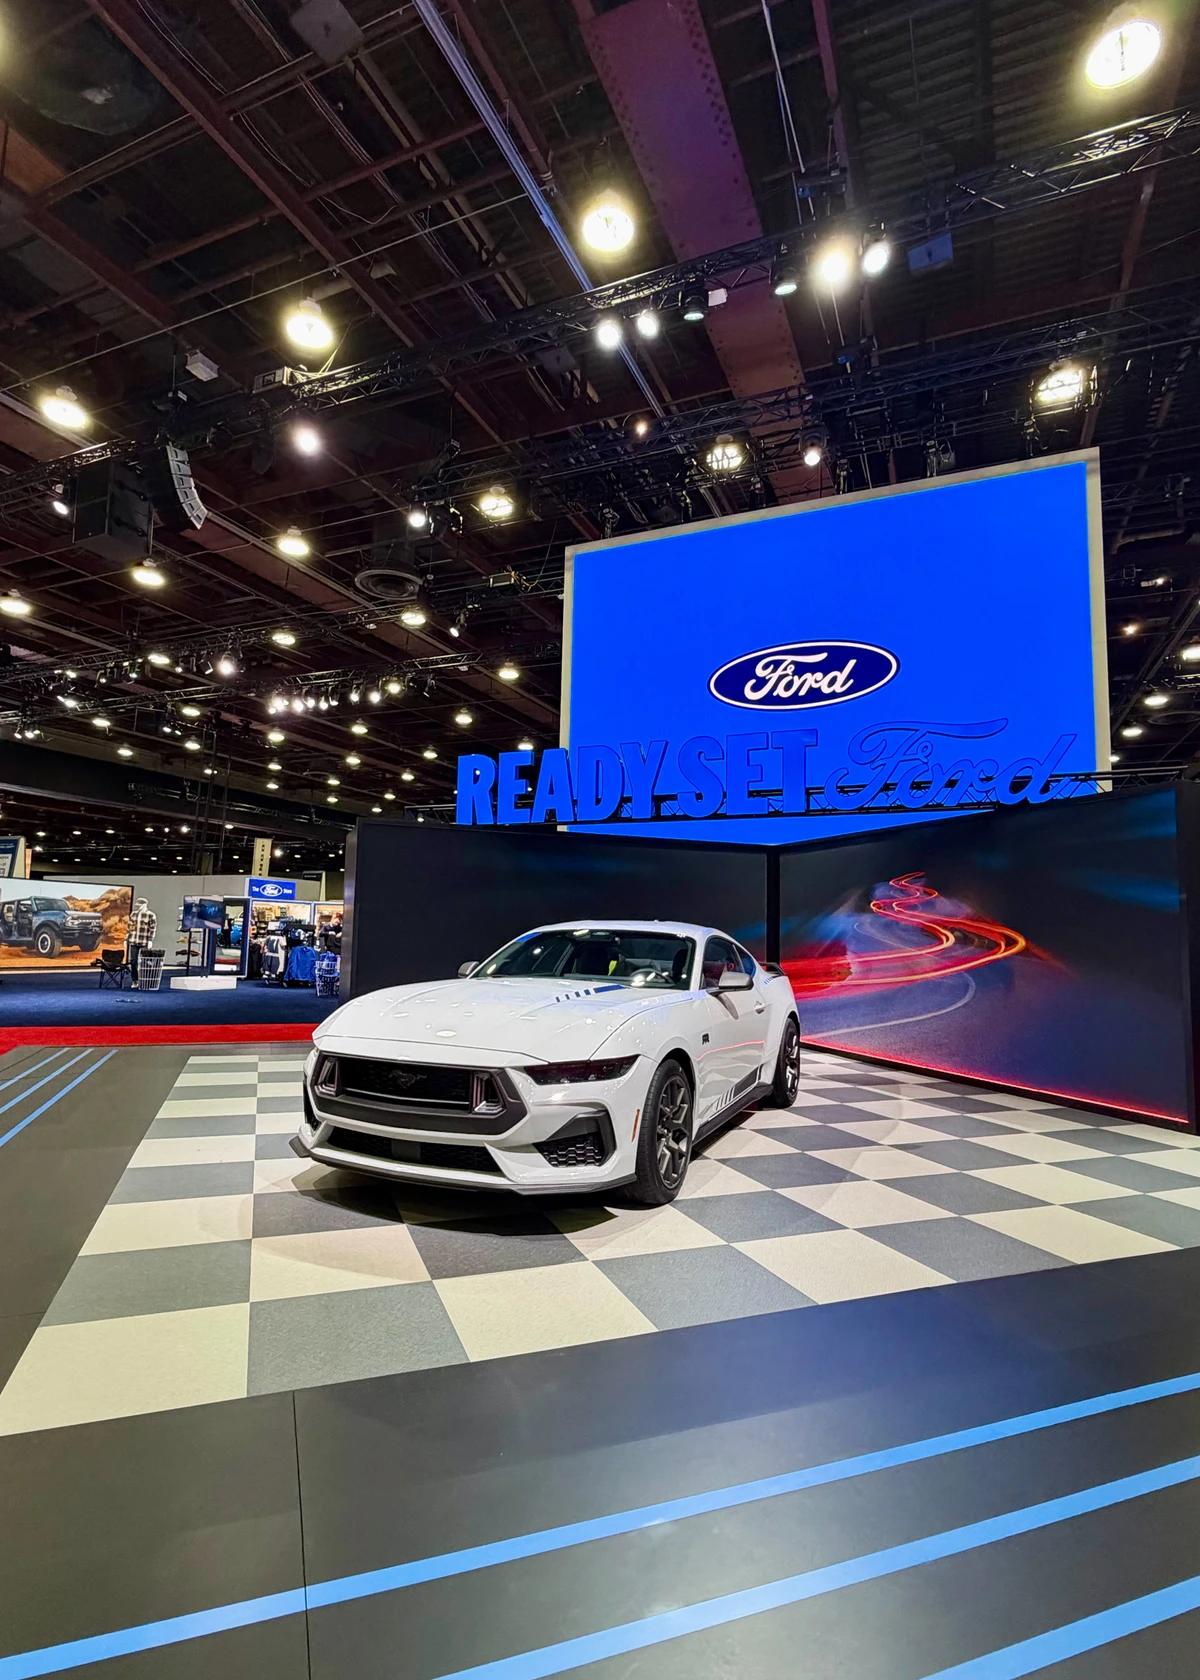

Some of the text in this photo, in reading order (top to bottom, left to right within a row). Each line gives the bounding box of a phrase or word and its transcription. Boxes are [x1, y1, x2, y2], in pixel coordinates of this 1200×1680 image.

[744, 652, 857, 701] Ford
[455, 717, 1078, 825] READY SET Ford
